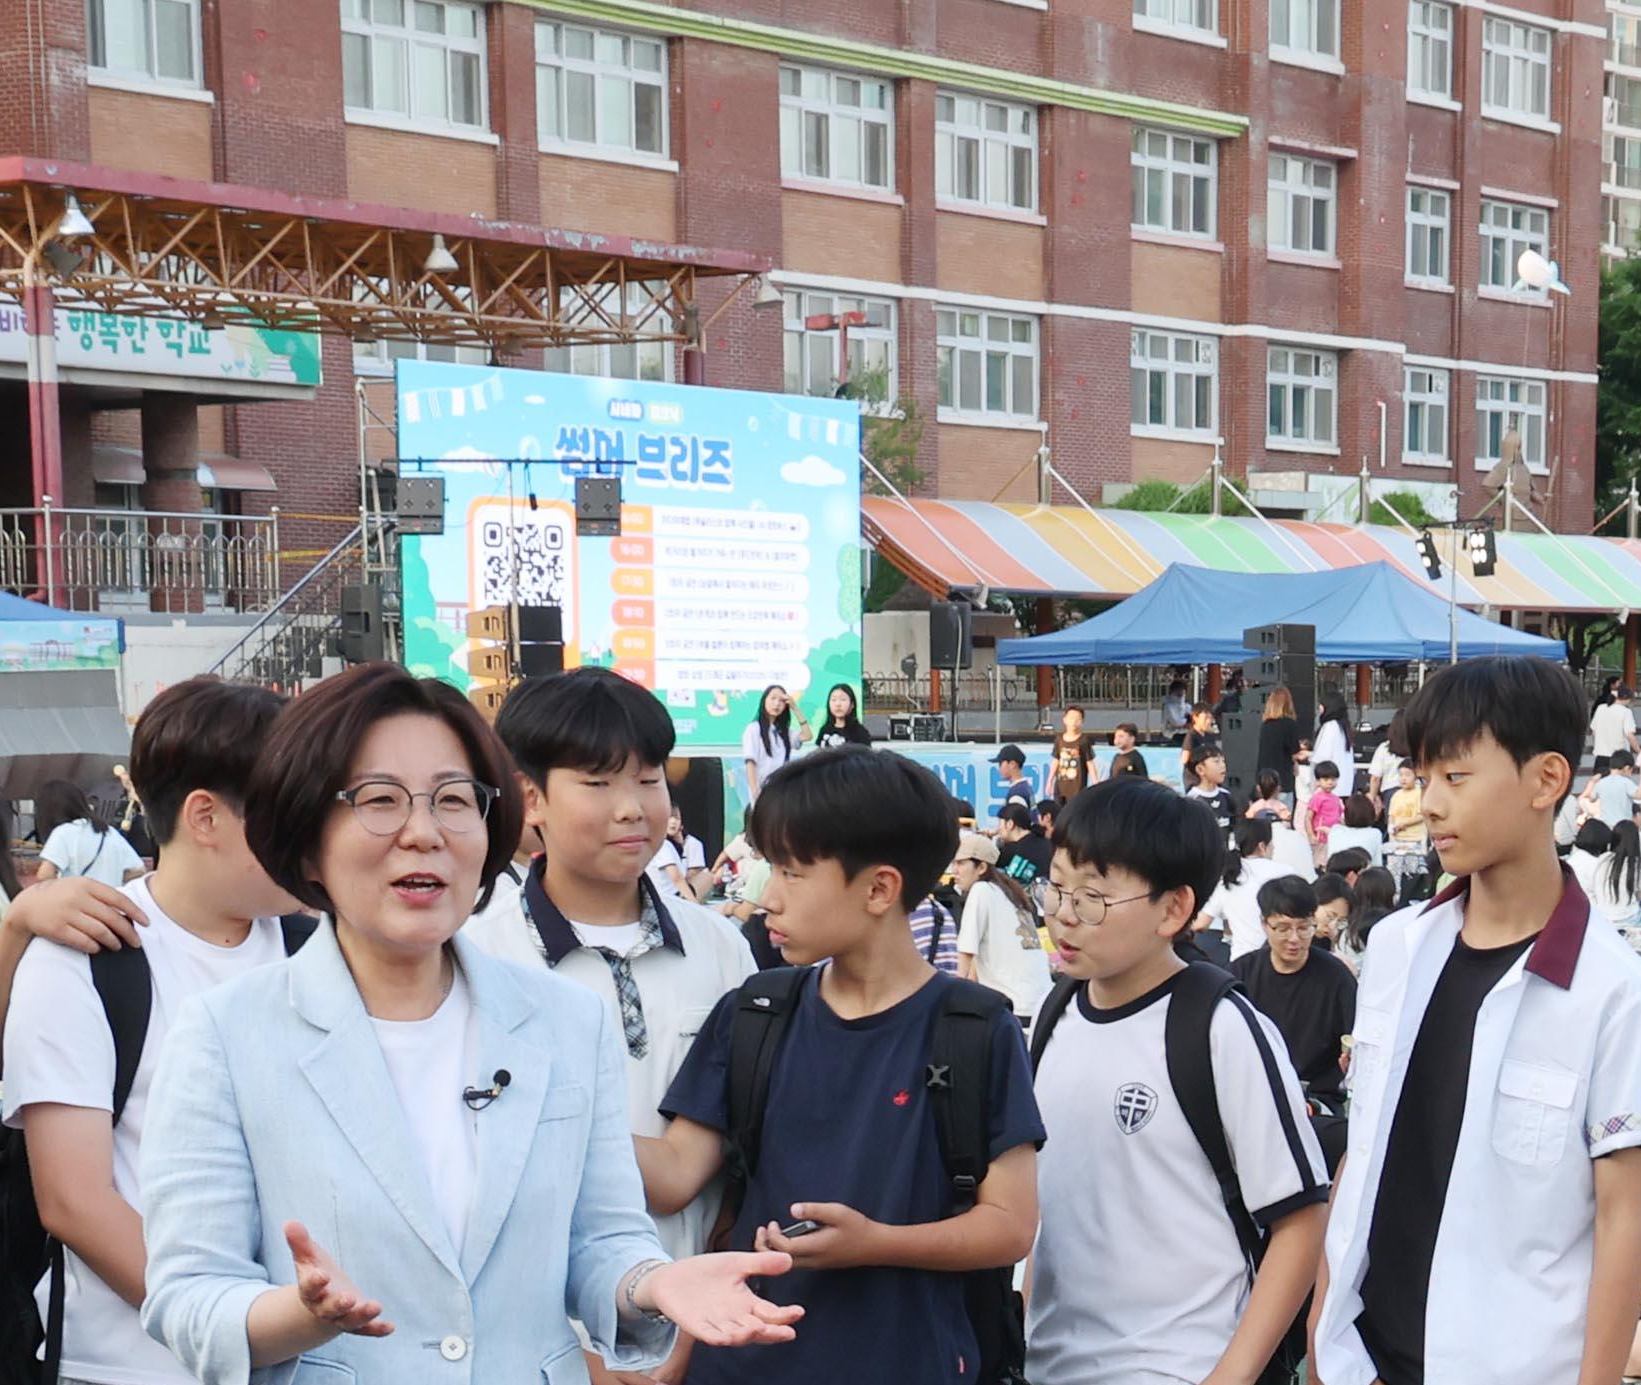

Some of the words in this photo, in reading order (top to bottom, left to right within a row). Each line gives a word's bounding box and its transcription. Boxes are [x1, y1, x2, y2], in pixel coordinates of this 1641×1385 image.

[66, 311, 149, 355] 행복한
[157, 314, 212, 359] 학교
[556, 427, 625, 478] 썸머
[636, 433, 733, 486] 브리즈
